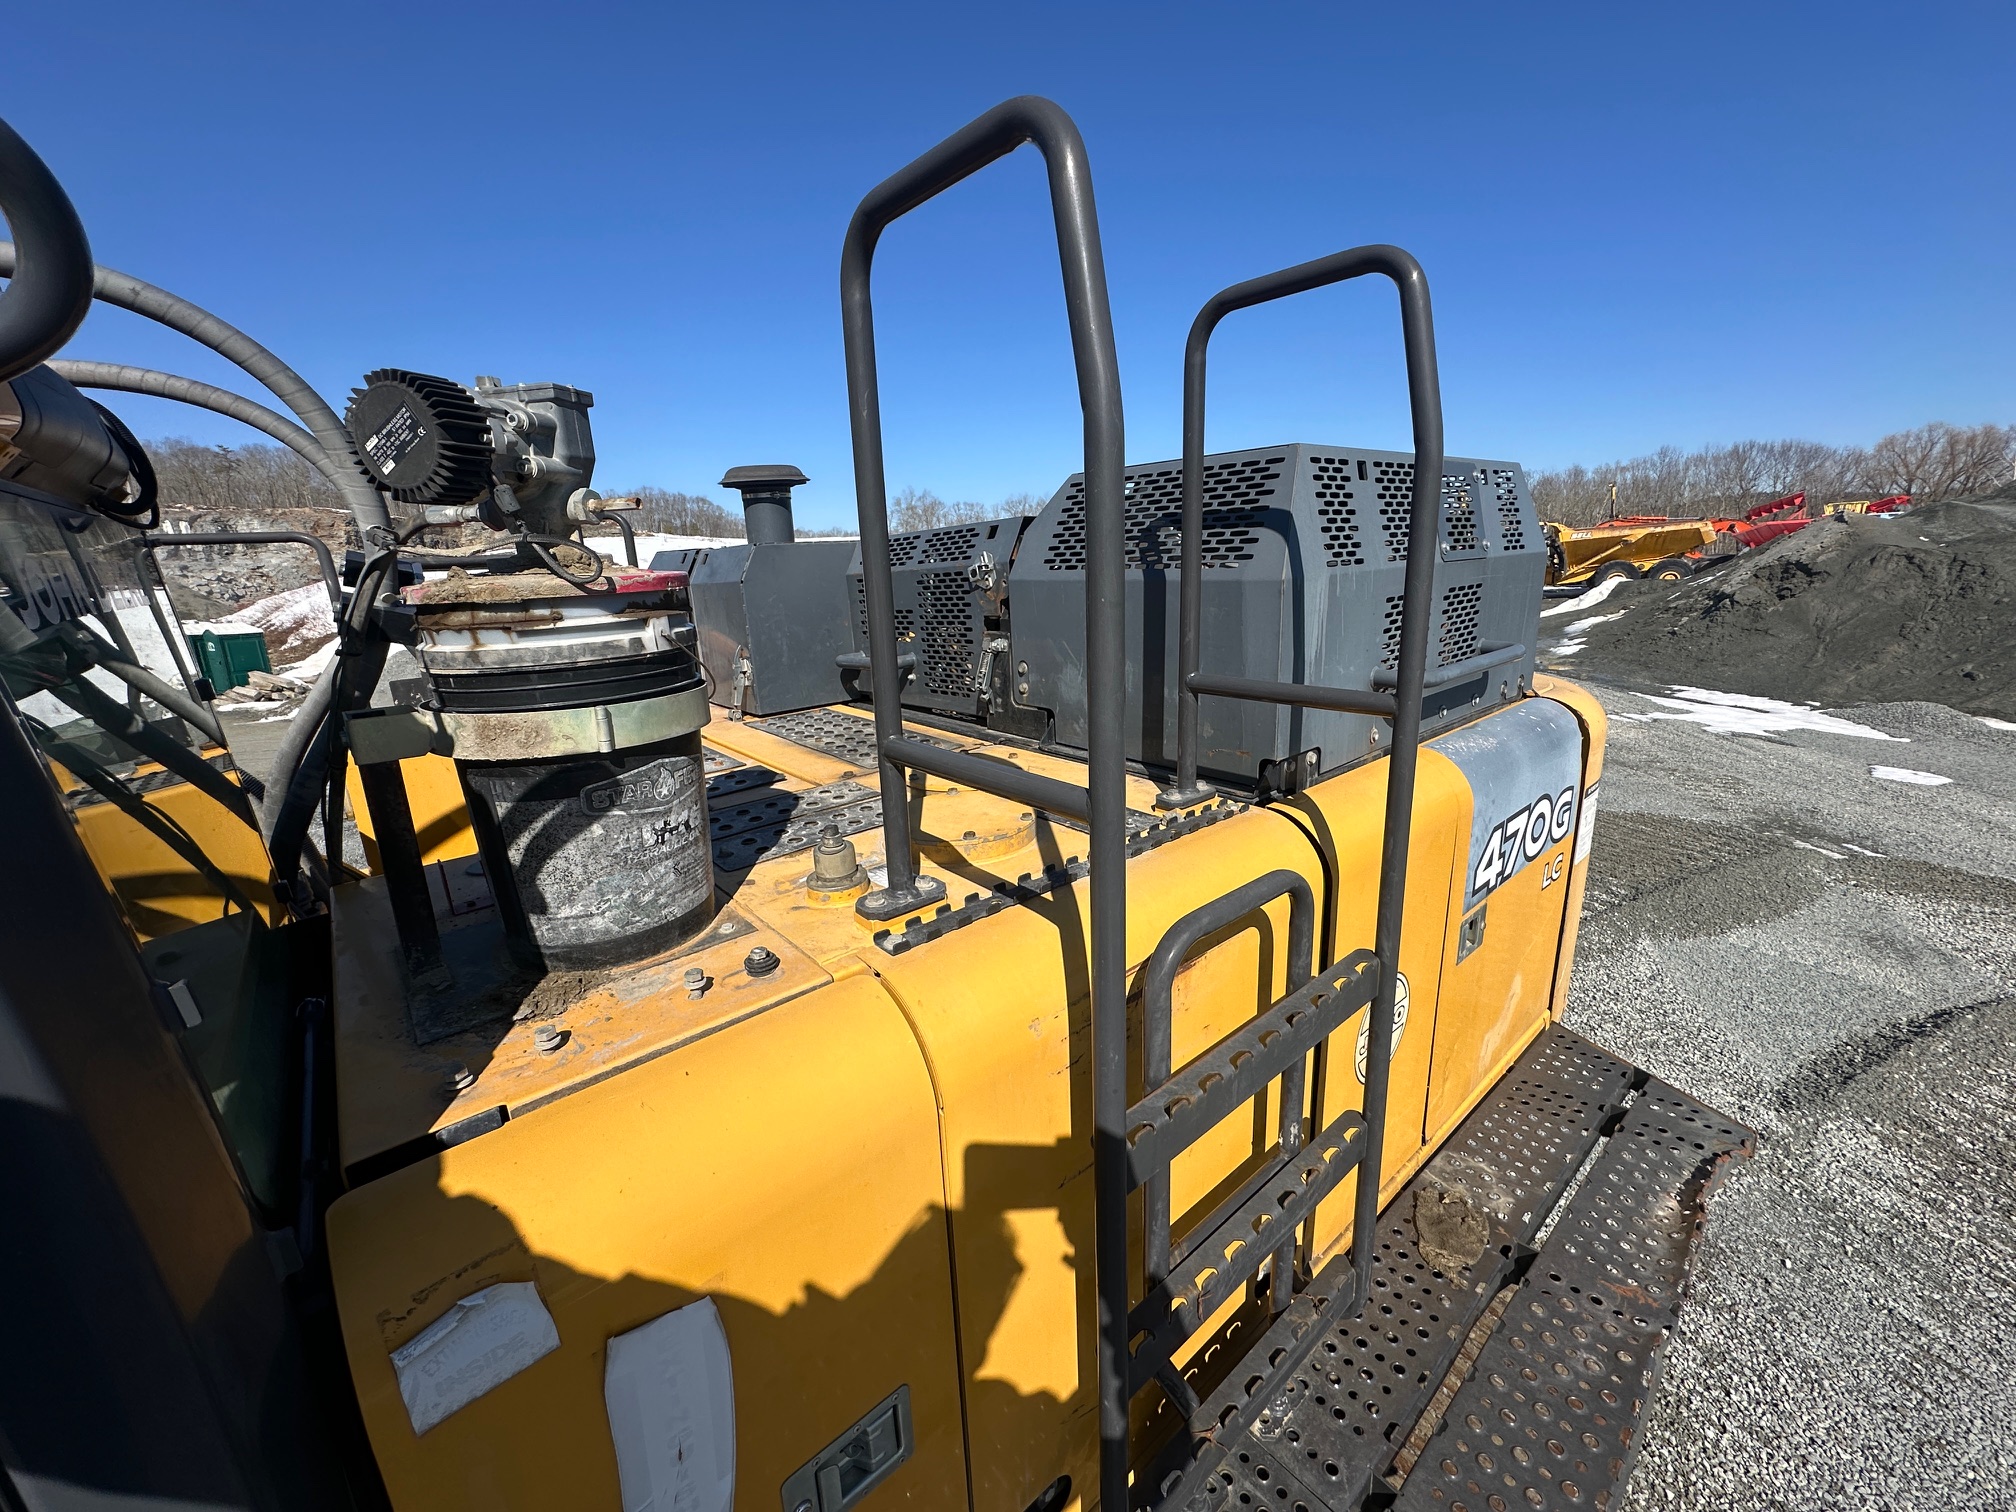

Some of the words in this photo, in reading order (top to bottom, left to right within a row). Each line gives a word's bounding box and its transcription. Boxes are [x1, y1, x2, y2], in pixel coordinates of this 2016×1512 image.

[592, 780, 653, 809] STAR
[1472, 785, 1574, 897] 470G
[1541, 852, 1564, 891] LC
